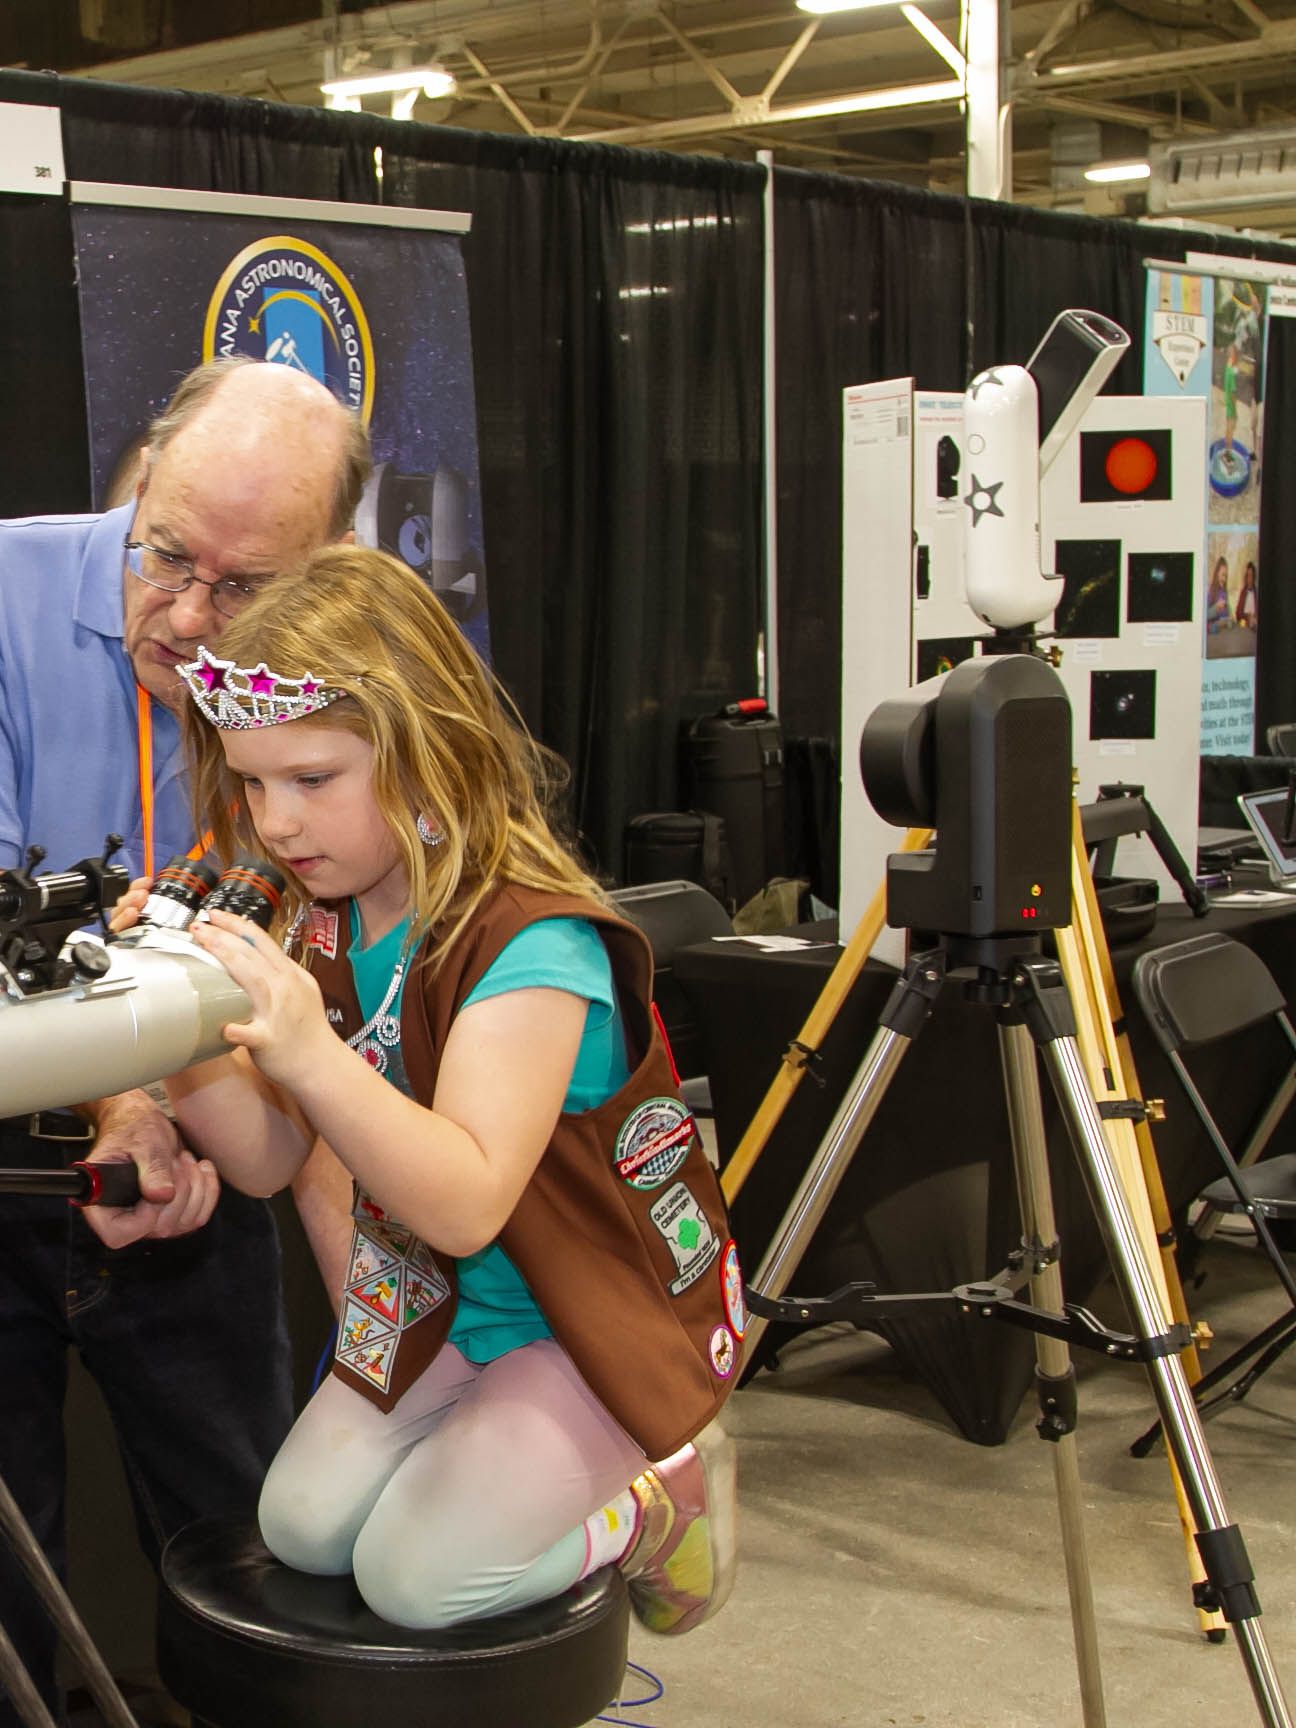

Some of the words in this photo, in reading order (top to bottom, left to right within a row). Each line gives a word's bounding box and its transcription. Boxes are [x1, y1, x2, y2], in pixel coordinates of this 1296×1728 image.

[234, 258, 346, 324] ASTRONOMICAL
[653, 1206, 668, 1222] OLD
[666, 1187, 687, 1208] UNION
[661, 1196, 691, 1230] CEMETERY
